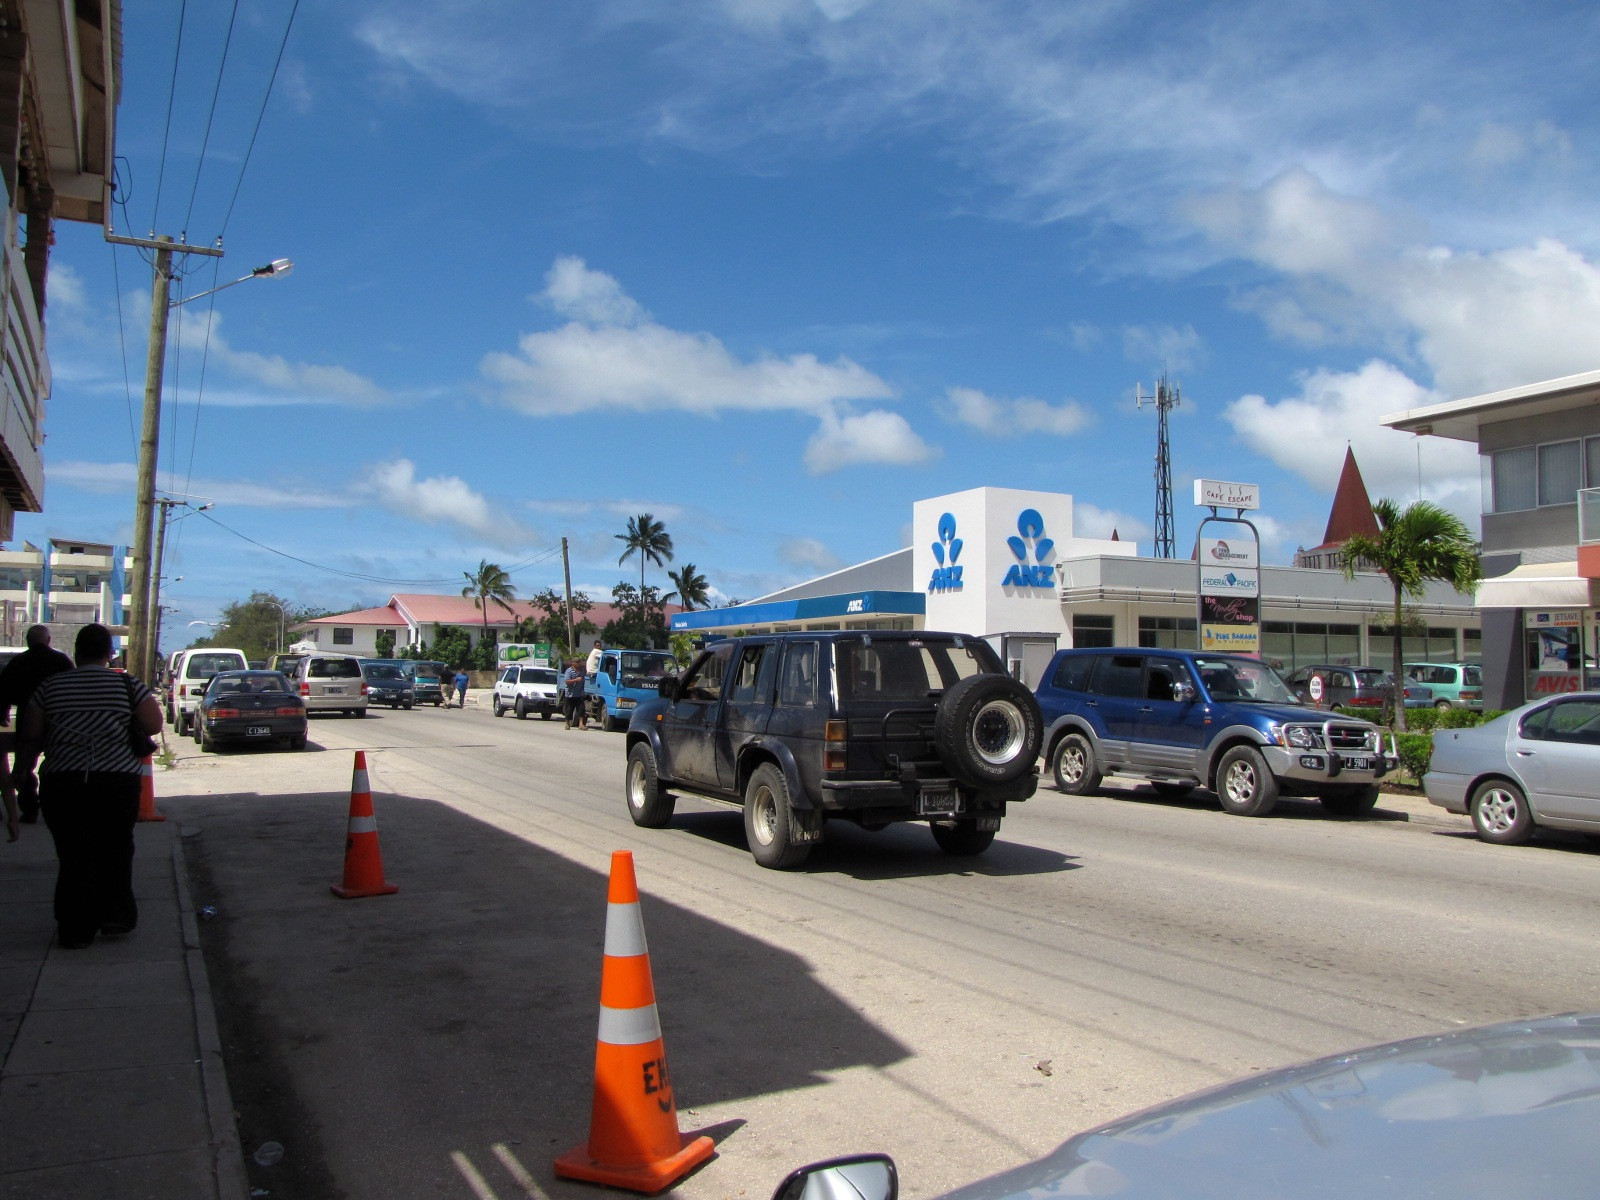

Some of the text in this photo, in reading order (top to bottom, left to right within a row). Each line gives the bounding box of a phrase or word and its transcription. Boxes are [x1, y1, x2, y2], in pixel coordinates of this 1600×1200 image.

[1207, 491, 1223, 500] CAFE
[928, 566, 963, 590] ANZ
[1001, 564, 1054, 588] ANZ
[847, 600, 862, 612] ANZ
[1236, 614, 1254, 622] shop
[1554, 613, 1578, 621] JETSAVE
[1534, 676, 1580, 692] AVIS
[1347, 758, 1351, 766] J
